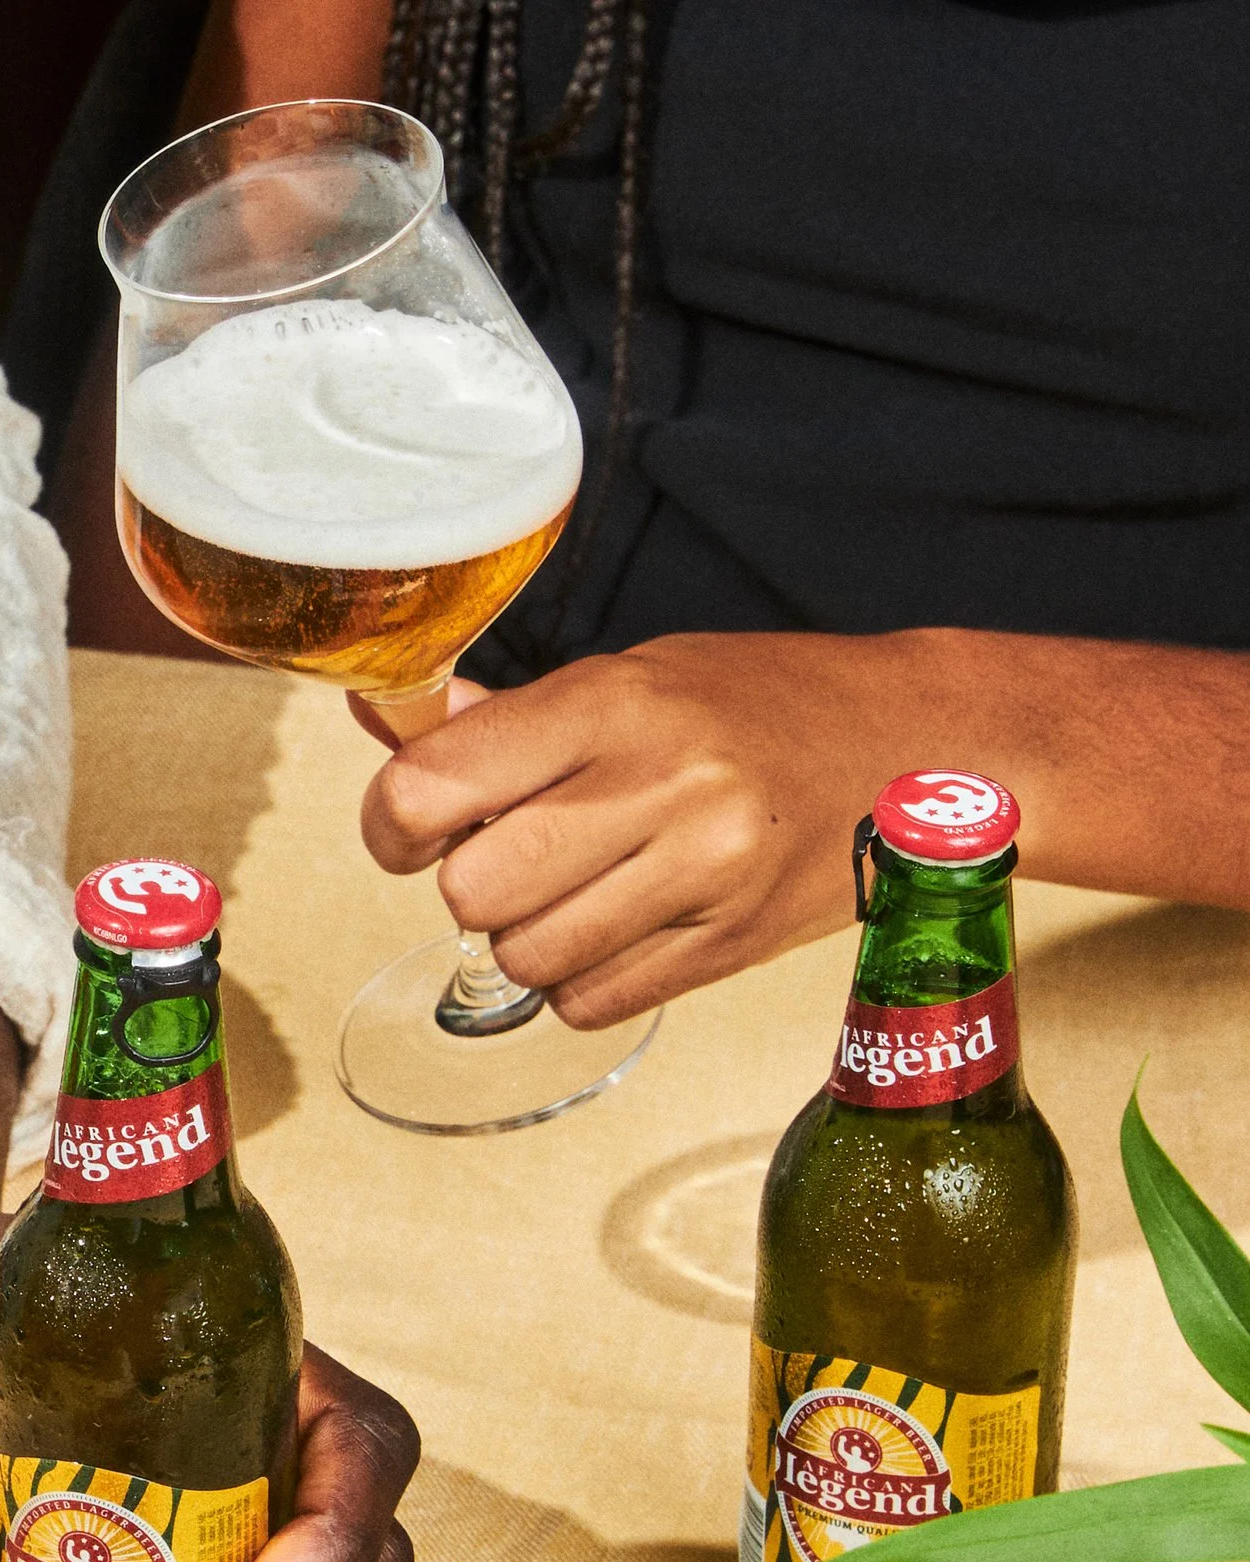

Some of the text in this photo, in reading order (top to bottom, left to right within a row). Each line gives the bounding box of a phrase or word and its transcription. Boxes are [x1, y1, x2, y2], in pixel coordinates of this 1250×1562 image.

[840, 1015, 997, 1086] legend
[851, 1023, 968, 1047] AFRICAN
[53, 1104, 211, 1182] legend
[63, 1113, 180, 1141] AFRICAN
[791, 1397, 933, 1462] IMPORTED LAGER BEER
[784, 1452, 938, 1516] legend
[802, 1460, 913, 1493] AFRICAN
[20, 1501, 162, 1561] IMPORTED LAGER BEER
[798, 1504, 902, 1536] PREMIUM QUAL
